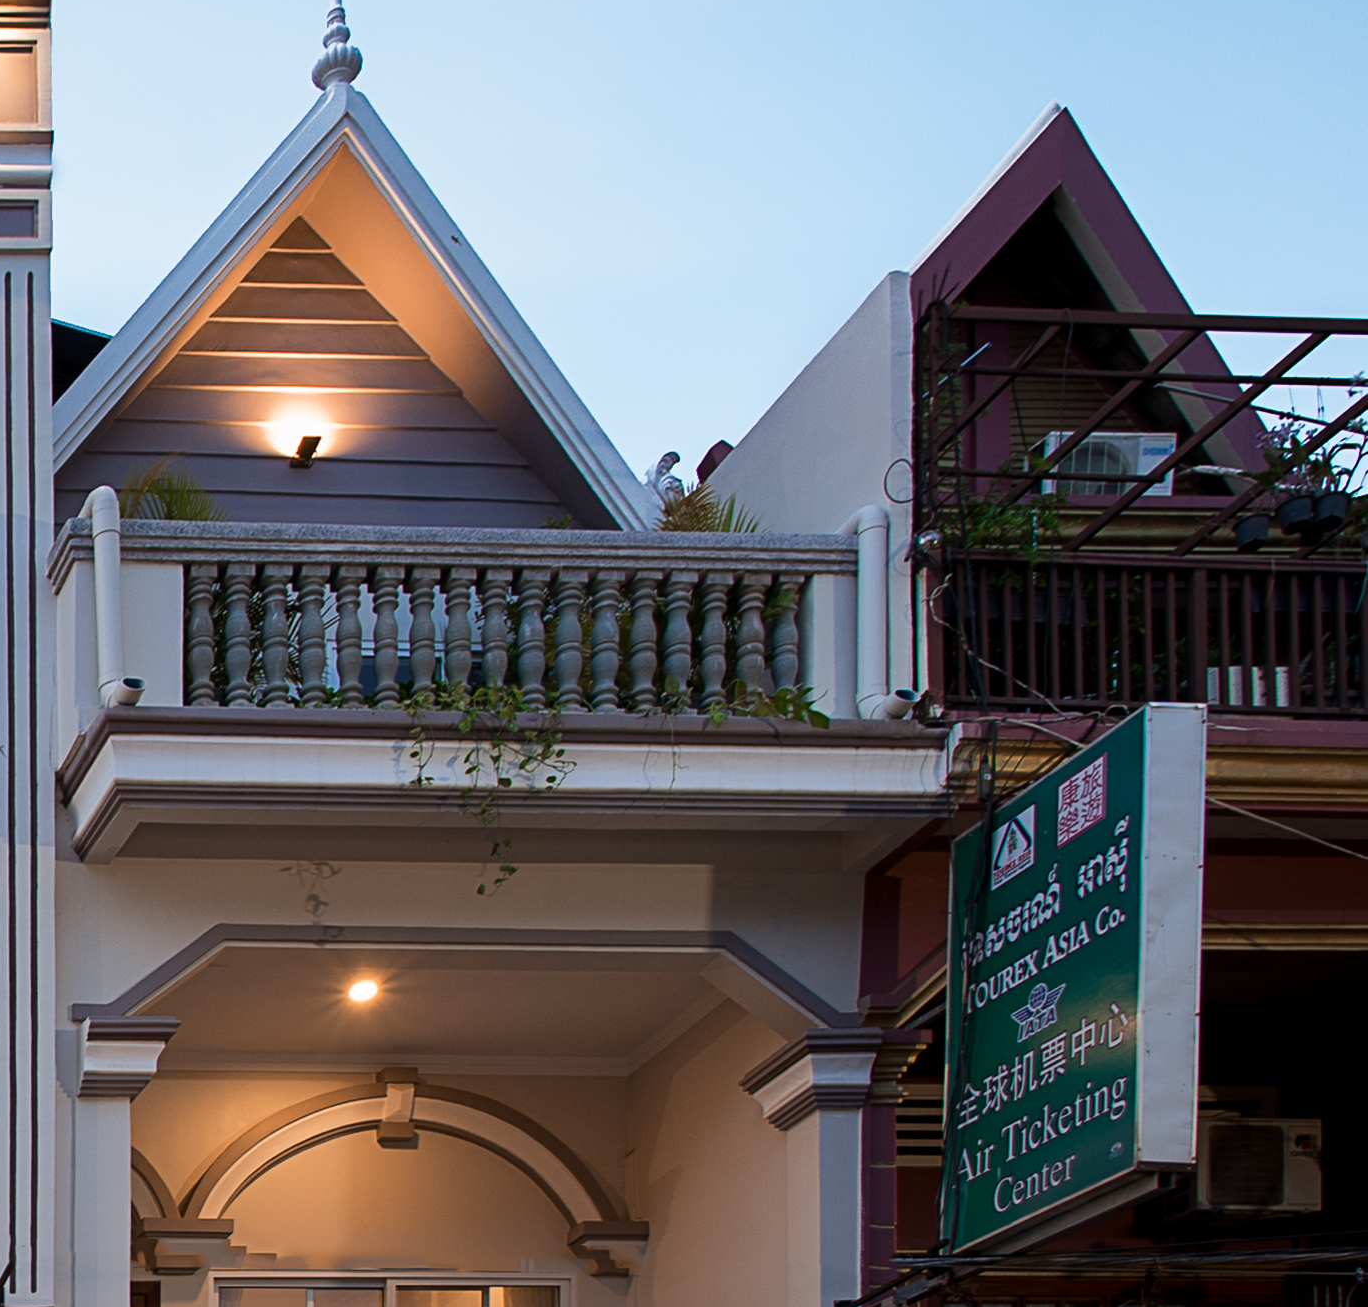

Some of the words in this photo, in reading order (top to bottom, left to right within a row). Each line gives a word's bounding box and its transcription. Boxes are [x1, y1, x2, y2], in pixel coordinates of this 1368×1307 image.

[966, 948, 1040, 1015] TOUREX
[1042, 920, 1092, 971] ASIA
[955, 1001, 1129, 1131] 全球机票中心
[1017, 1006, 1058, 1043] IATA
[957, 1137, 997, 1183] Air
[1000, 1075, 1129, 1163] Ticketing
[992, 1153, 1078, 1214] Center
